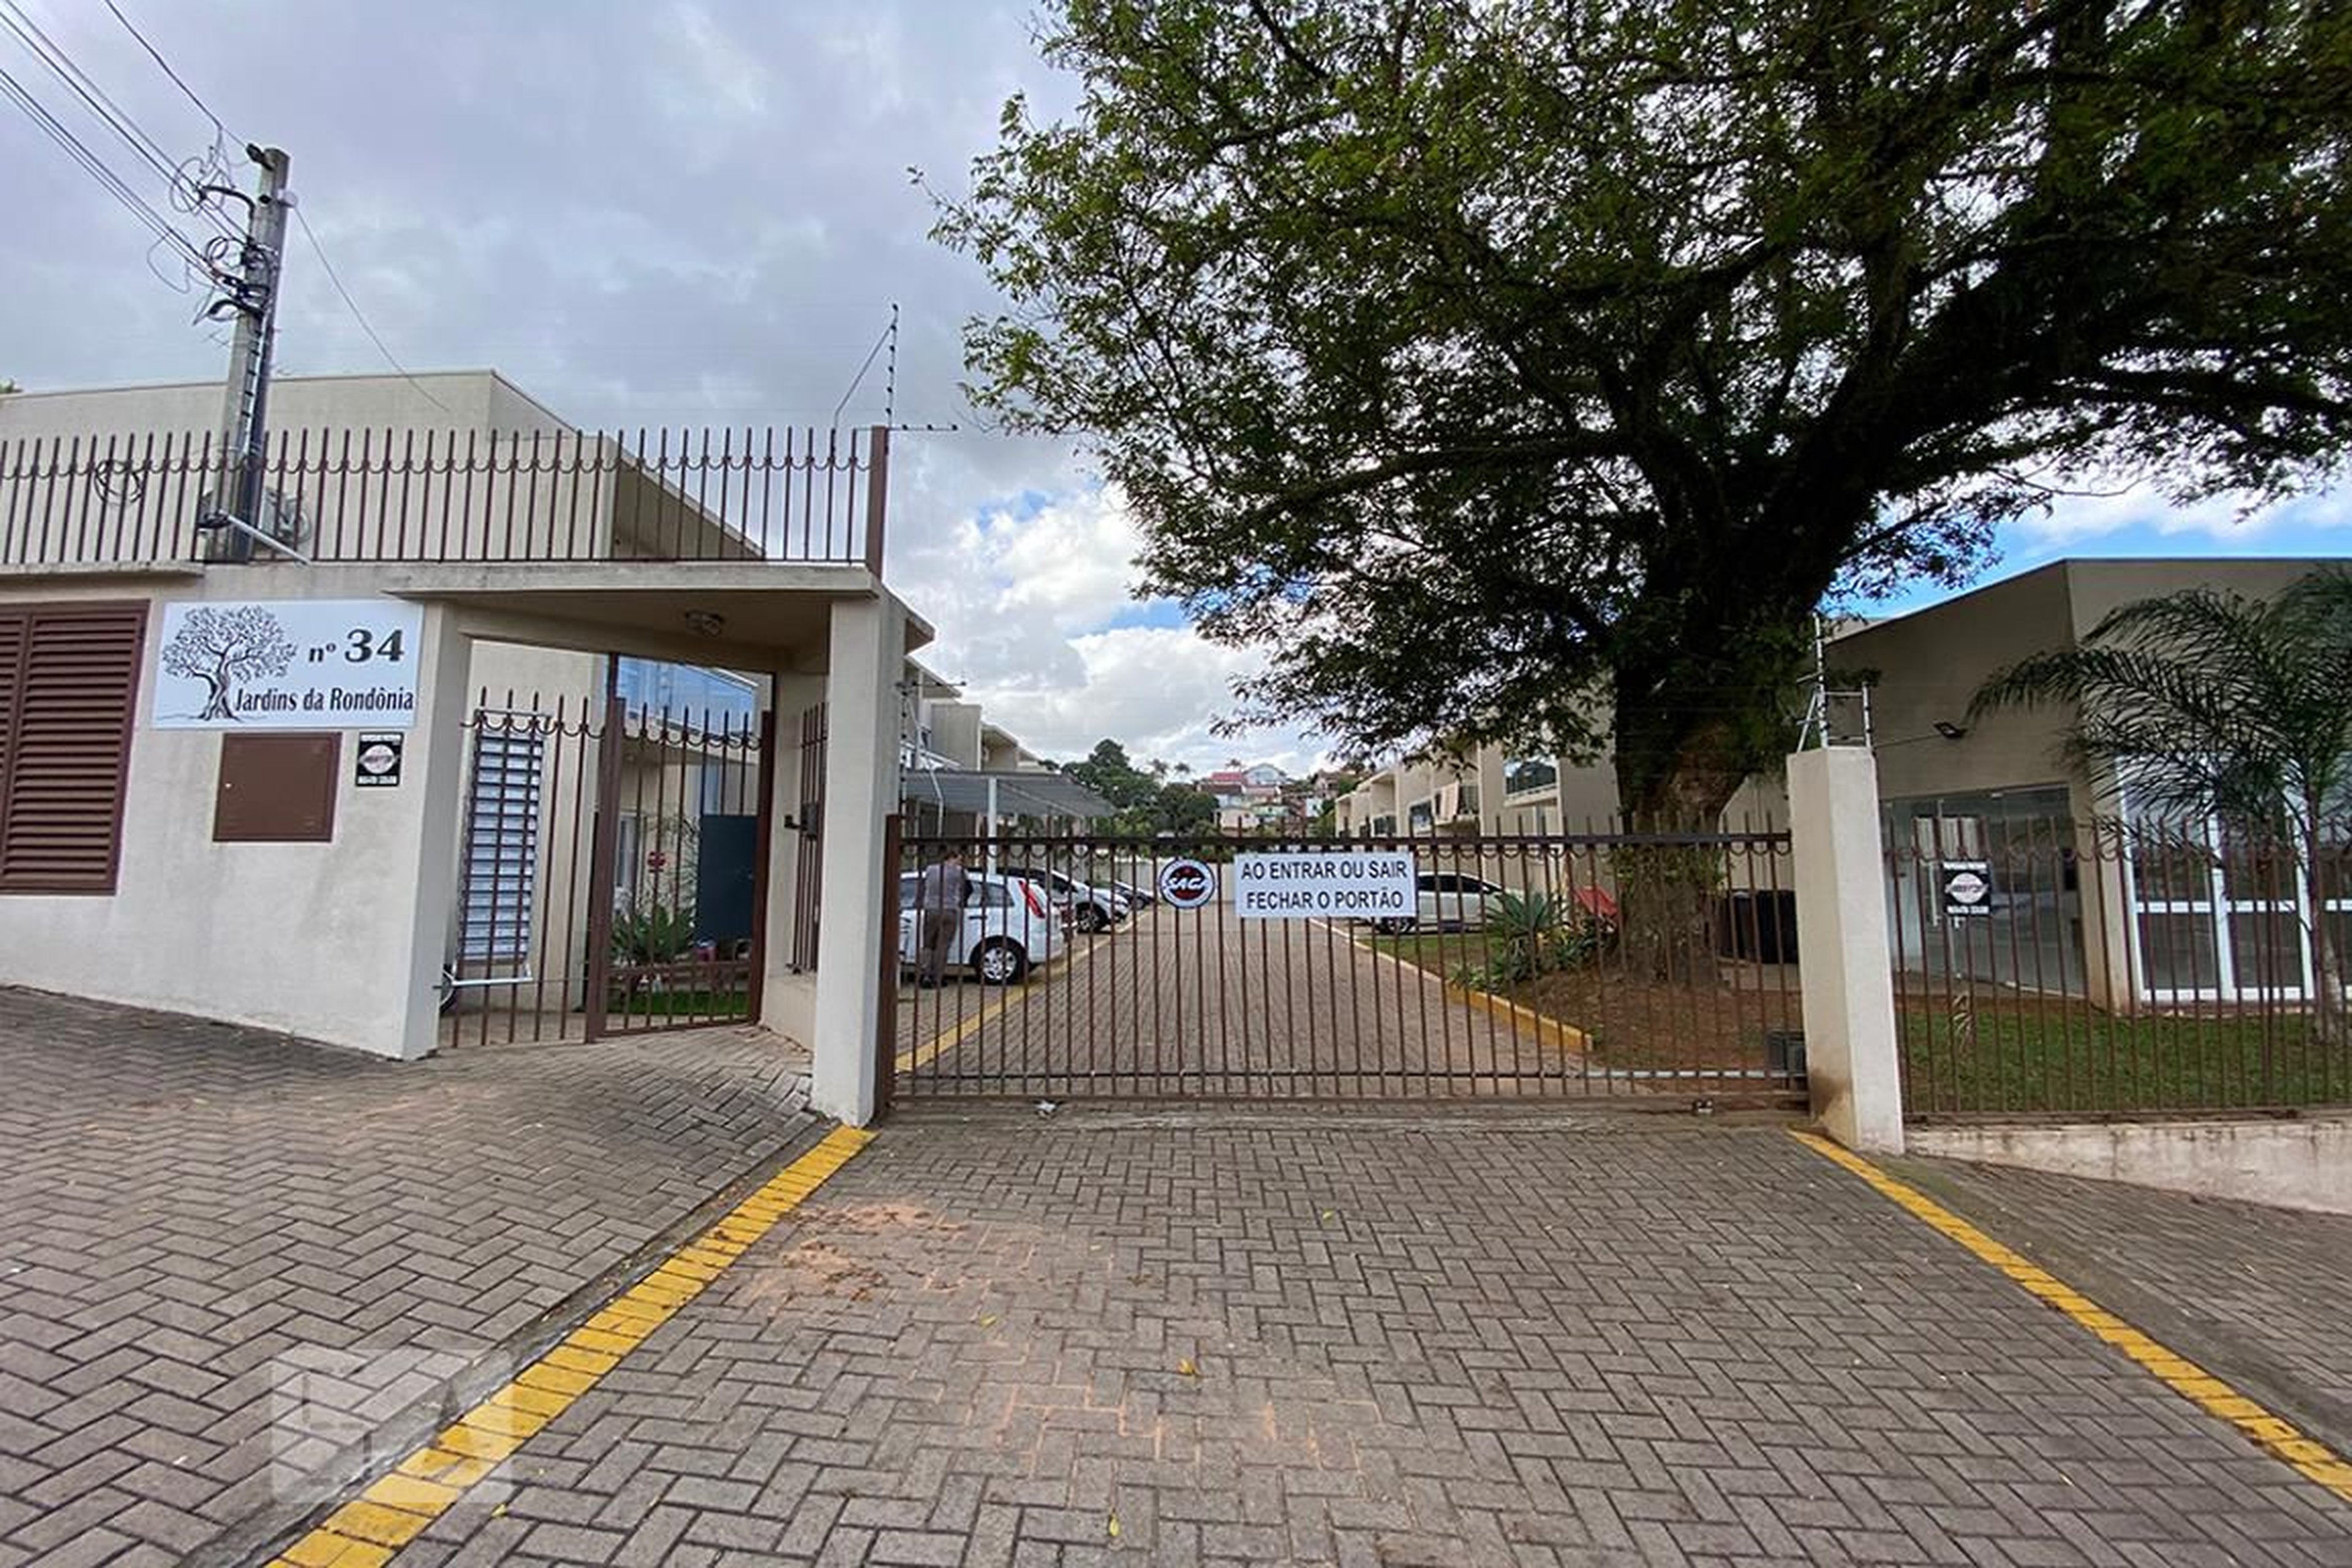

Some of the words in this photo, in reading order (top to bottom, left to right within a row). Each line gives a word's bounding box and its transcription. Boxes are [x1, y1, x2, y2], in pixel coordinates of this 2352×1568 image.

[345, 628, 404, 663] 34
[235, 687, 298, 711] Jardins
[303, 687, 324, 711] da
[1241, 862, 1265, 880] AO
[1270, 861, 1336, 880] ENTRAR
[1341, 861, 1364, 879] OU
[1369, 860, 1408, 878] SAIR
[1246, 891, 1313, 910] FECHAR
[1317, 891, 1330, 909] O
[1335, 886, 1403, 909] PORTÃO
